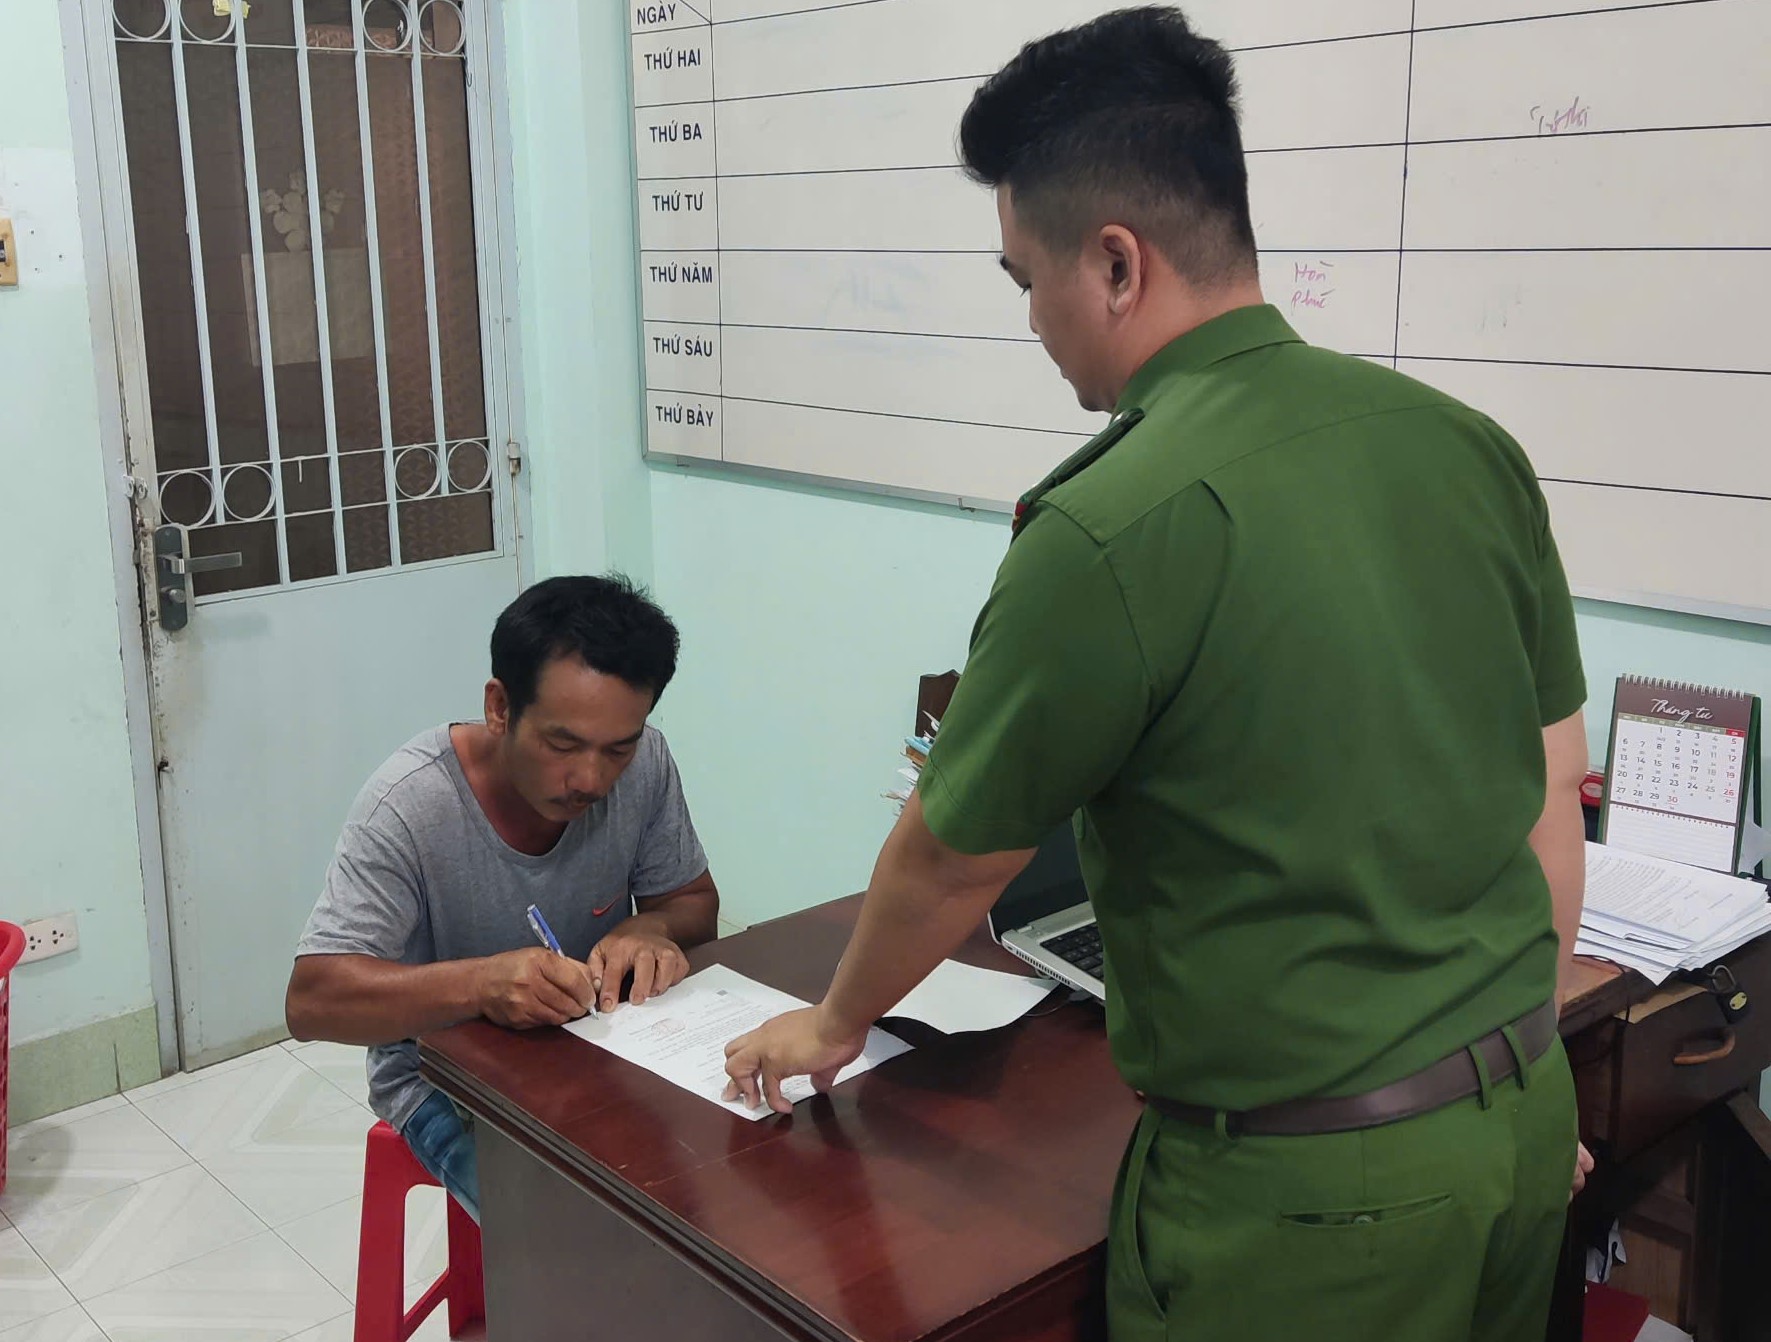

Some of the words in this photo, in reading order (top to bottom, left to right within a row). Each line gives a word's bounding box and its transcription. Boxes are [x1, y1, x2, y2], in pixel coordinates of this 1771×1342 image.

[637, 0, 676, 25] NGÀY
[644, 46, 673, 71] THỨ
[677, 48, 701, 68] HAI
[649, 119, 678, 143] THỨ
[683, 122, 702, 141] BA
[652, 189, 681, 211] THỨ
[684, 191, 704, 211] TƯ
[649, 261, 678, 283] THỨ
[682, 261, 713, 283] NĂM
[653, 333, 681, 355] THỨ
[684, 335, 712, 357] SÁU
[655, 402, 683, 424] THỨ
[686, 403, 714, 427] BẢY
[1650, 698, 1694, 724] Tháng
